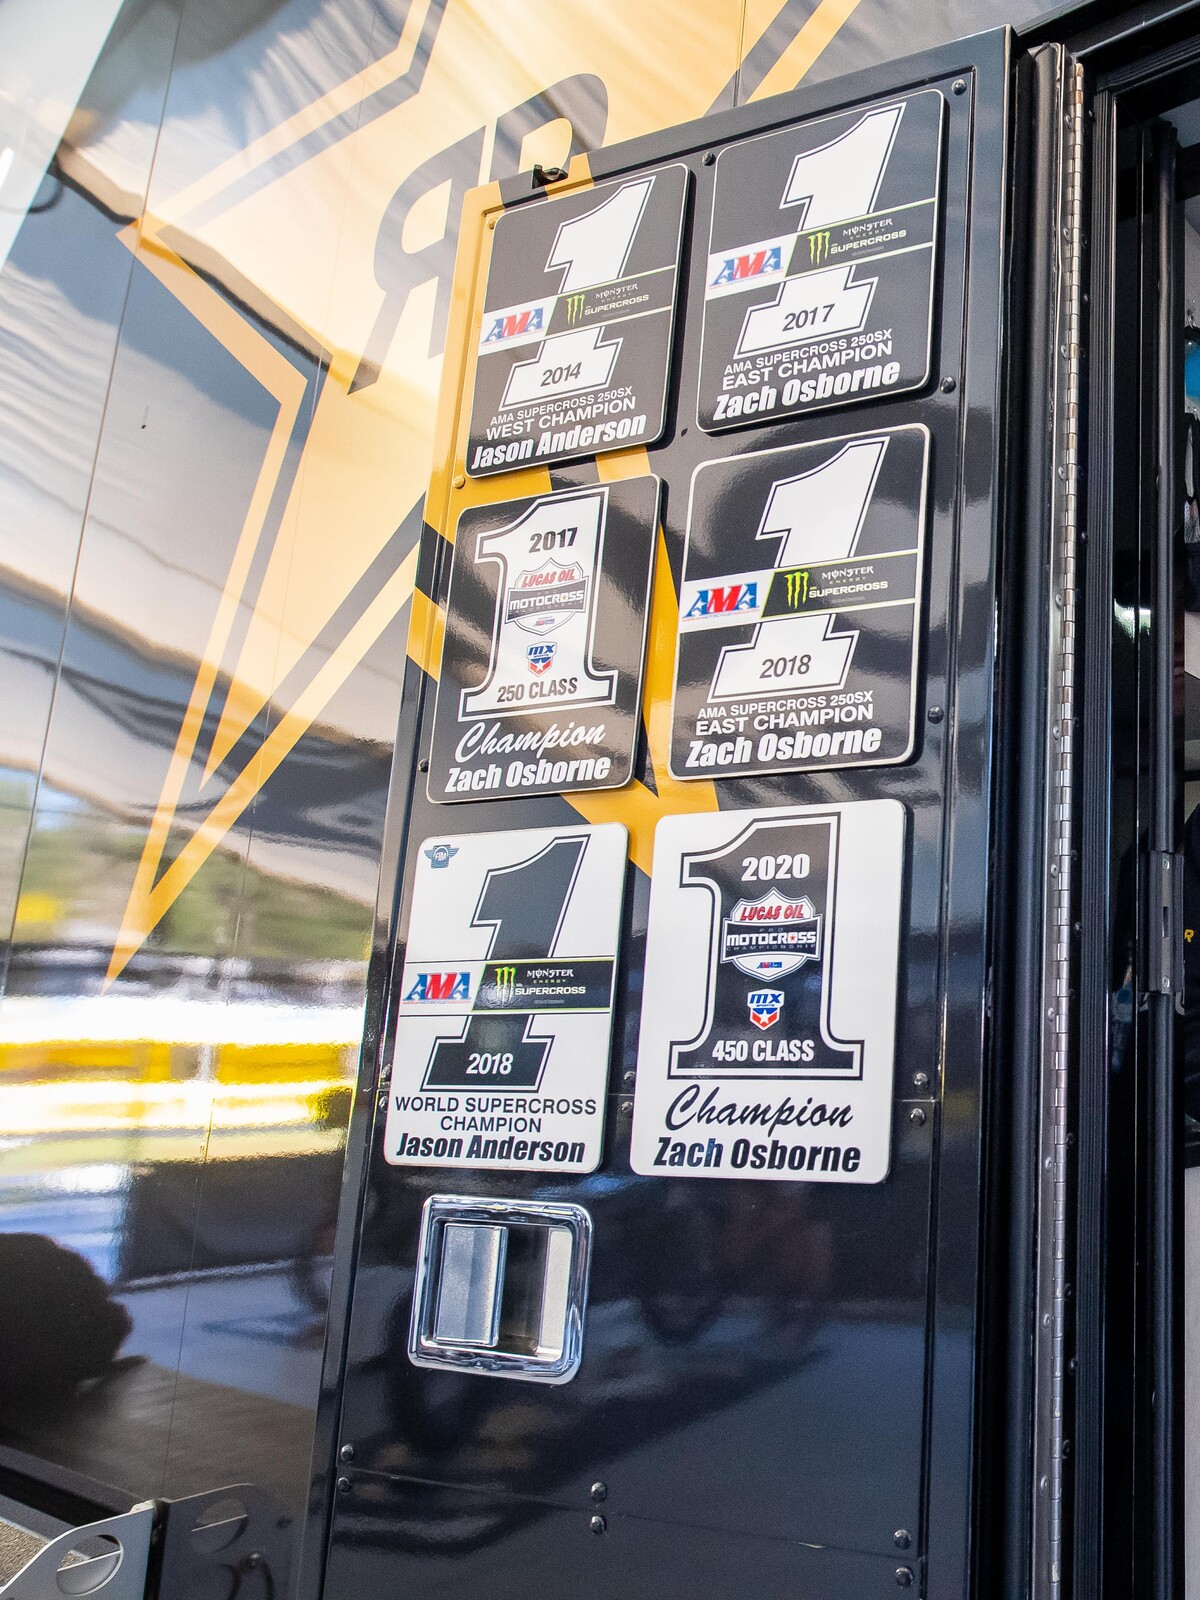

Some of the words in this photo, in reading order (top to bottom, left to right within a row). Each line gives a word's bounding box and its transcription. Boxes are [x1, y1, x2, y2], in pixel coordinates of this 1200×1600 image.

[843, 217, 893, 237] MONSTER
[830, 229, 907, 254] SUPERCROSS
[711, 246, 784, 286] AMA
[596, 283, 638, 299] MONSTER
[584, 294, 649, 316] SUPERCROSS
[782, 303, 835, 332] 2017
[482, 307, 544, 342] AMA
[724, 360, 752, 375] AMA
[756, 339, 847, 368] SUPERCROSS
[851, 328, 892, 347] 250SX
[540, 362, 582, 387] 2014
[722, 368, 774, 391] EAST
[778, 340, 893, 378] CHAMPION
[713, 385, 777, 421] Zach
[781, 361, 901, 406] Osborne
[486, 419, 535, 441] WEST
[539, 396, 636, 429] CHAMPION
[490, 414, 514, 426] AMA
[517, 395, 594, 420] SUPERCROSS
[597, 386, 633, 402] 250SX
[471, 438, 533, 469] Jason
[535, 414, 647, 456] Anderson
[529, 526, 578, 553] 2017
[521, 571, 557, 589] LUCAS
[558, 568, 575, 582] OIL
[822, 566, 874, 580] MONSTER
[509, 590, 584, 611] MOTOCROSS
[683, 582, 759, 618] AMA
[809, 581, 888, 598] SUPERCROSS
[759, 654, 812, 679] 2018
[496, 684, 525, 703] 250
[529, 677, 578, 699] CLASS
[697, 707, 726, 719] AMA
[730, 697, 826, 716] SUPERCROSS
[830, 690, 873, 705] 250SX
[695, 717, 748, 736] EAST
[753, 704, 873, 731] CHAMPION
[454, 721, 606, 763] Champion
[685, 736, 752, 768] Zach
[757, 727, 882, 762] Osborne
[444, 764, 502, 792] Zach
[505, 756, 611, 788] Osborne
[741, 853, 810, 882] 2020
[740, 905, 782, 921] LUCAS
[784, 904, 804, 919] OIL
[726, 931, 816, 946] MOTOCROSS
[726, 944, 816, 952] CHAMPIONSHIP
[404, 972, 472, 1000] AMA
[527, 968, 574, 979] MONSTER
[515, 986, 586, 995] SUPERCROSS
[466, 1052, 514, 1075] 2018
[711, 1040, 748, 1062] 450
[752, 1039, 815, 1062] CLASS
[395, 1096, 459, 1112] WORLD
[465, 1097, 597, 1115] SUPERCROSS
[665, 1084, 853, 1137] Champion
[440, 1116, 542, 1133] CHAMPION
[396, 1132, 463, 1158] Jason
[466, 1134, 586, 1163] Anderson
[653, 1136, 723, 1167] Zach
[730, 1138, 861, 1172] Osborne
